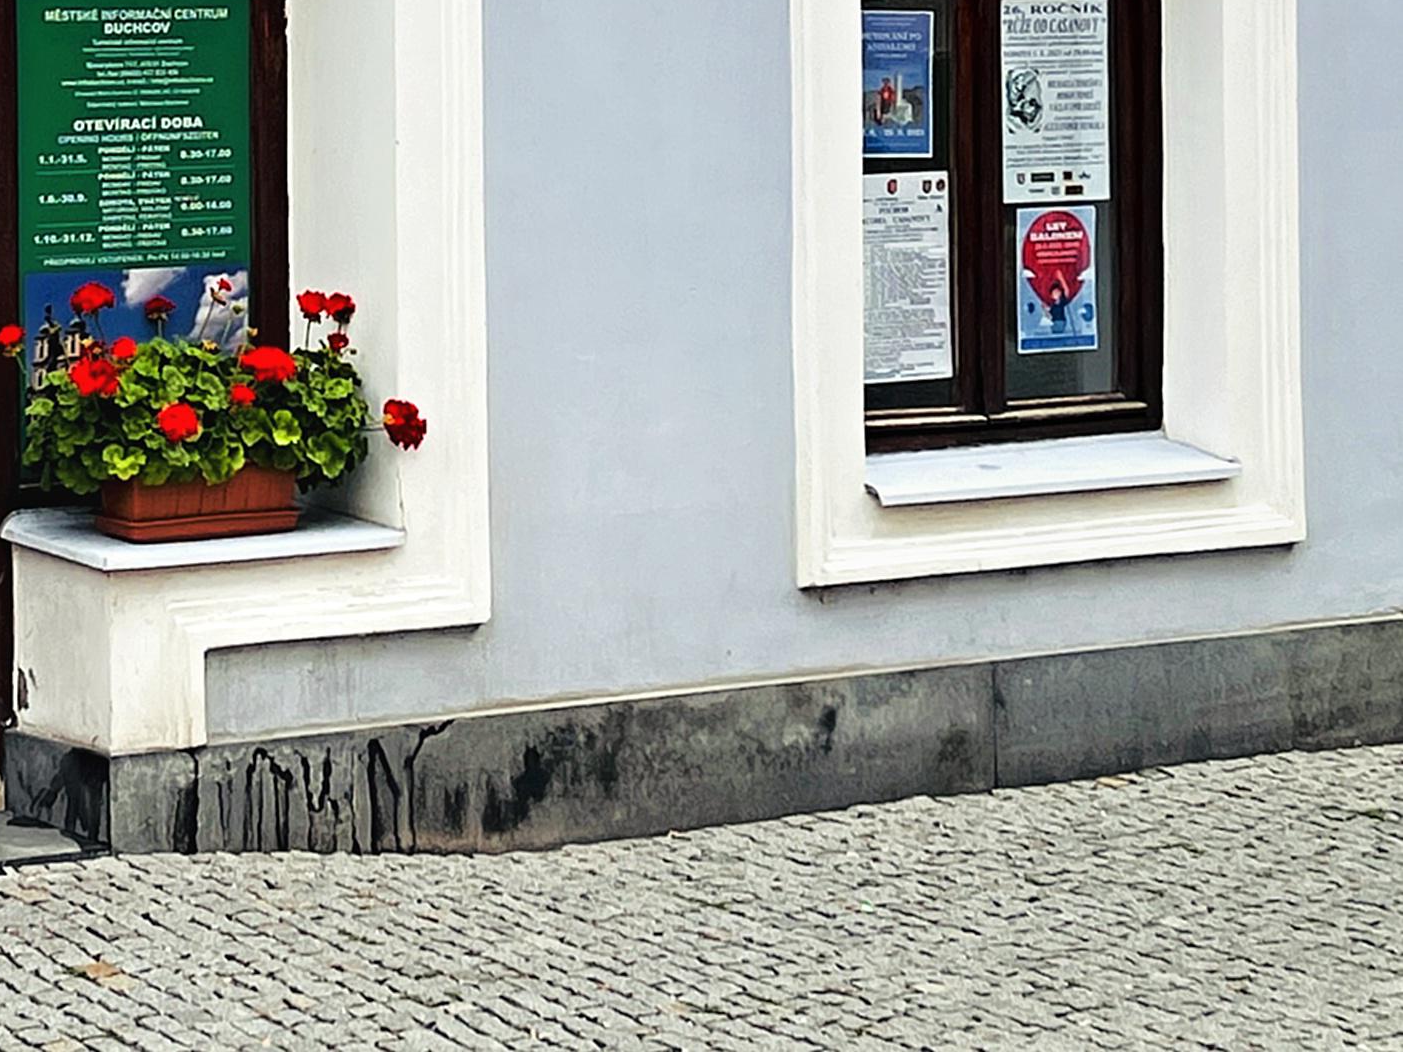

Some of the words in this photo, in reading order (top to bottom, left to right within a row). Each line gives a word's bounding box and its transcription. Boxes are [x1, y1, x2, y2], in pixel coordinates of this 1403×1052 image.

[45, 8, 98, 22] MĚSTSKÉ
[101, 7, 172, 22] INFORMAČNÍ
[174, 8, 229, 21] CENTRUM
[1030, 2, 1103, 15] ROČNÍK
[73, 116, 157, 133] OTEVÍRACÍ
[161, 116, 204, 130] DOBA
